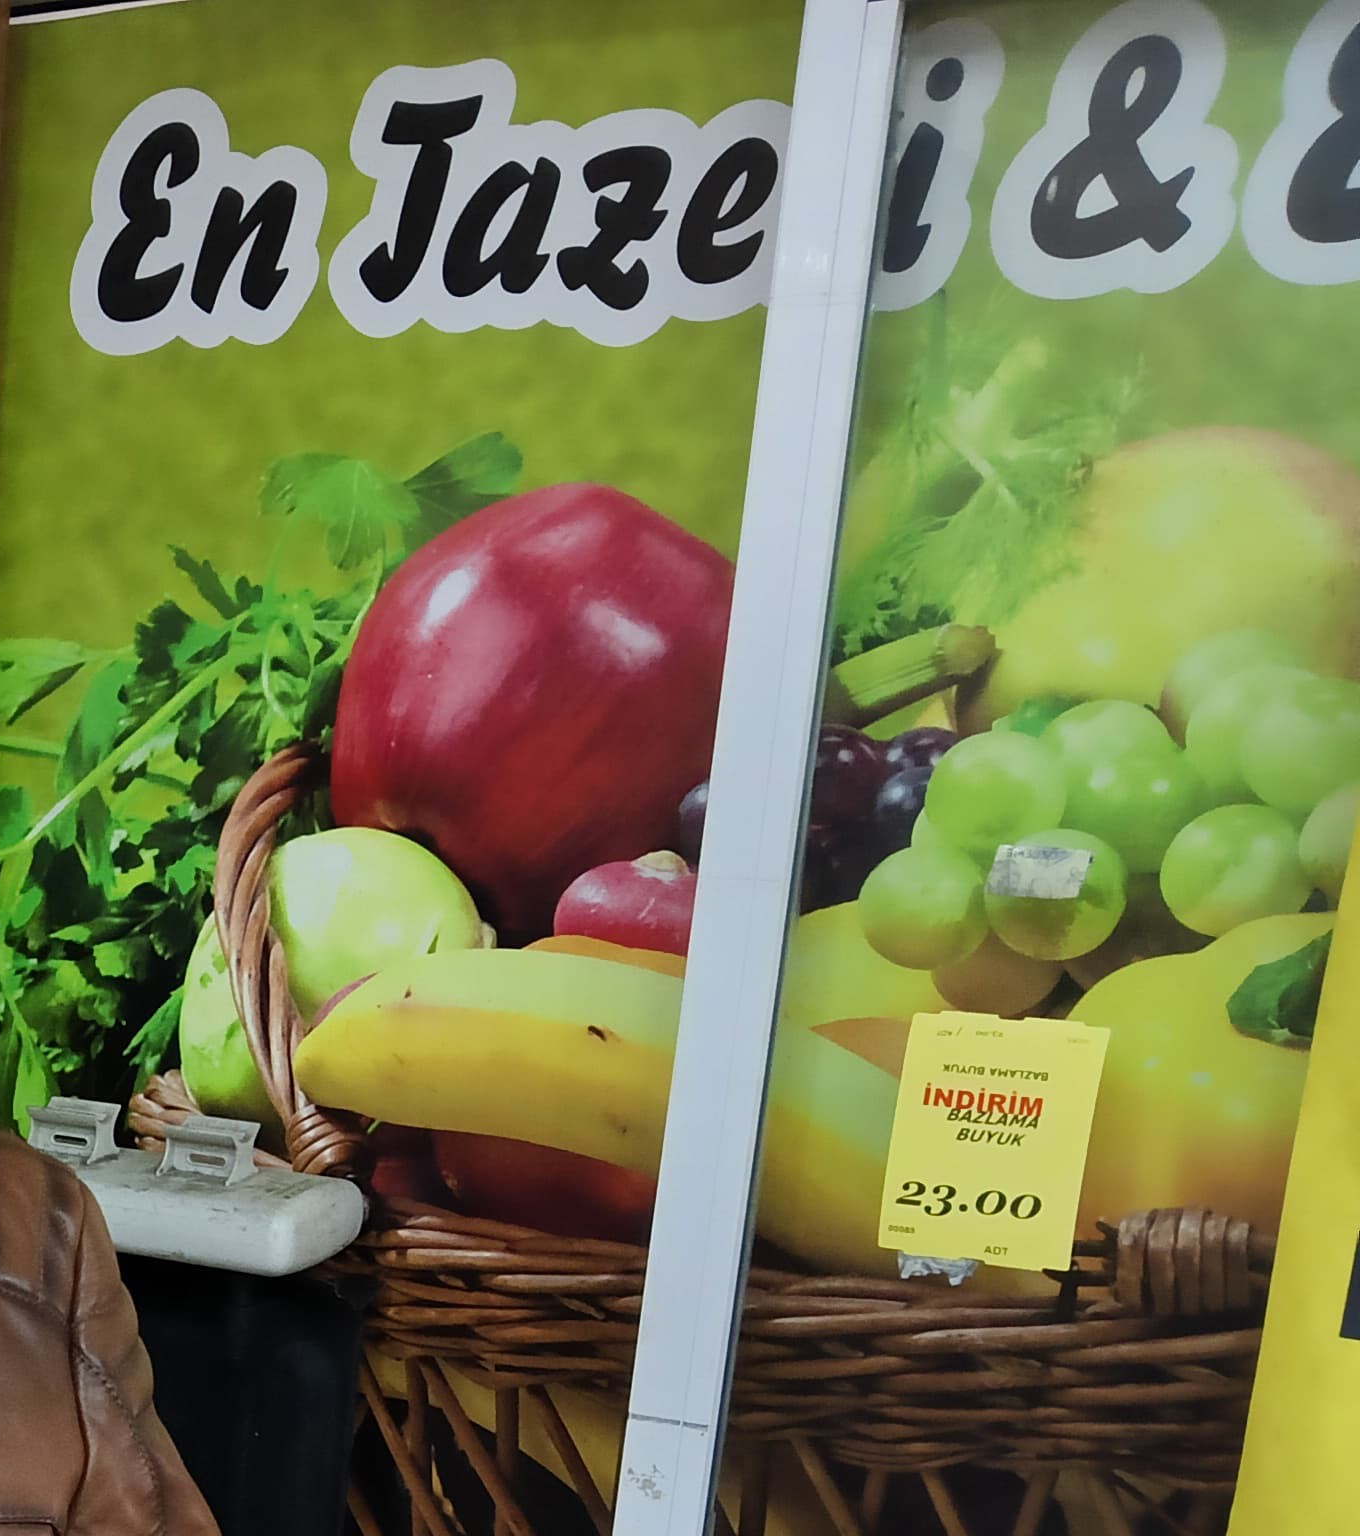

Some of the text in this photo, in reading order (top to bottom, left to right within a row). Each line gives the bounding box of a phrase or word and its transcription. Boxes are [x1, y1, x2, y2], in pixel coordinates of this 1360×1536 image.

[94, 120, 300, 323] En
[1028, 33, 1197, 261] &
[943, 1064, 1048, 1081] BAZLAMA BUYUK
[922, 1082, 1044, 1118] İNDİRİM
[946, 1108, 1040, 1129] BAZLAMA
[956, 1128, 1026, 1147] BUYUK
[895, 1180, 1042, 1220] 23.00
[984, 1245, 1008, 1256] ADT
